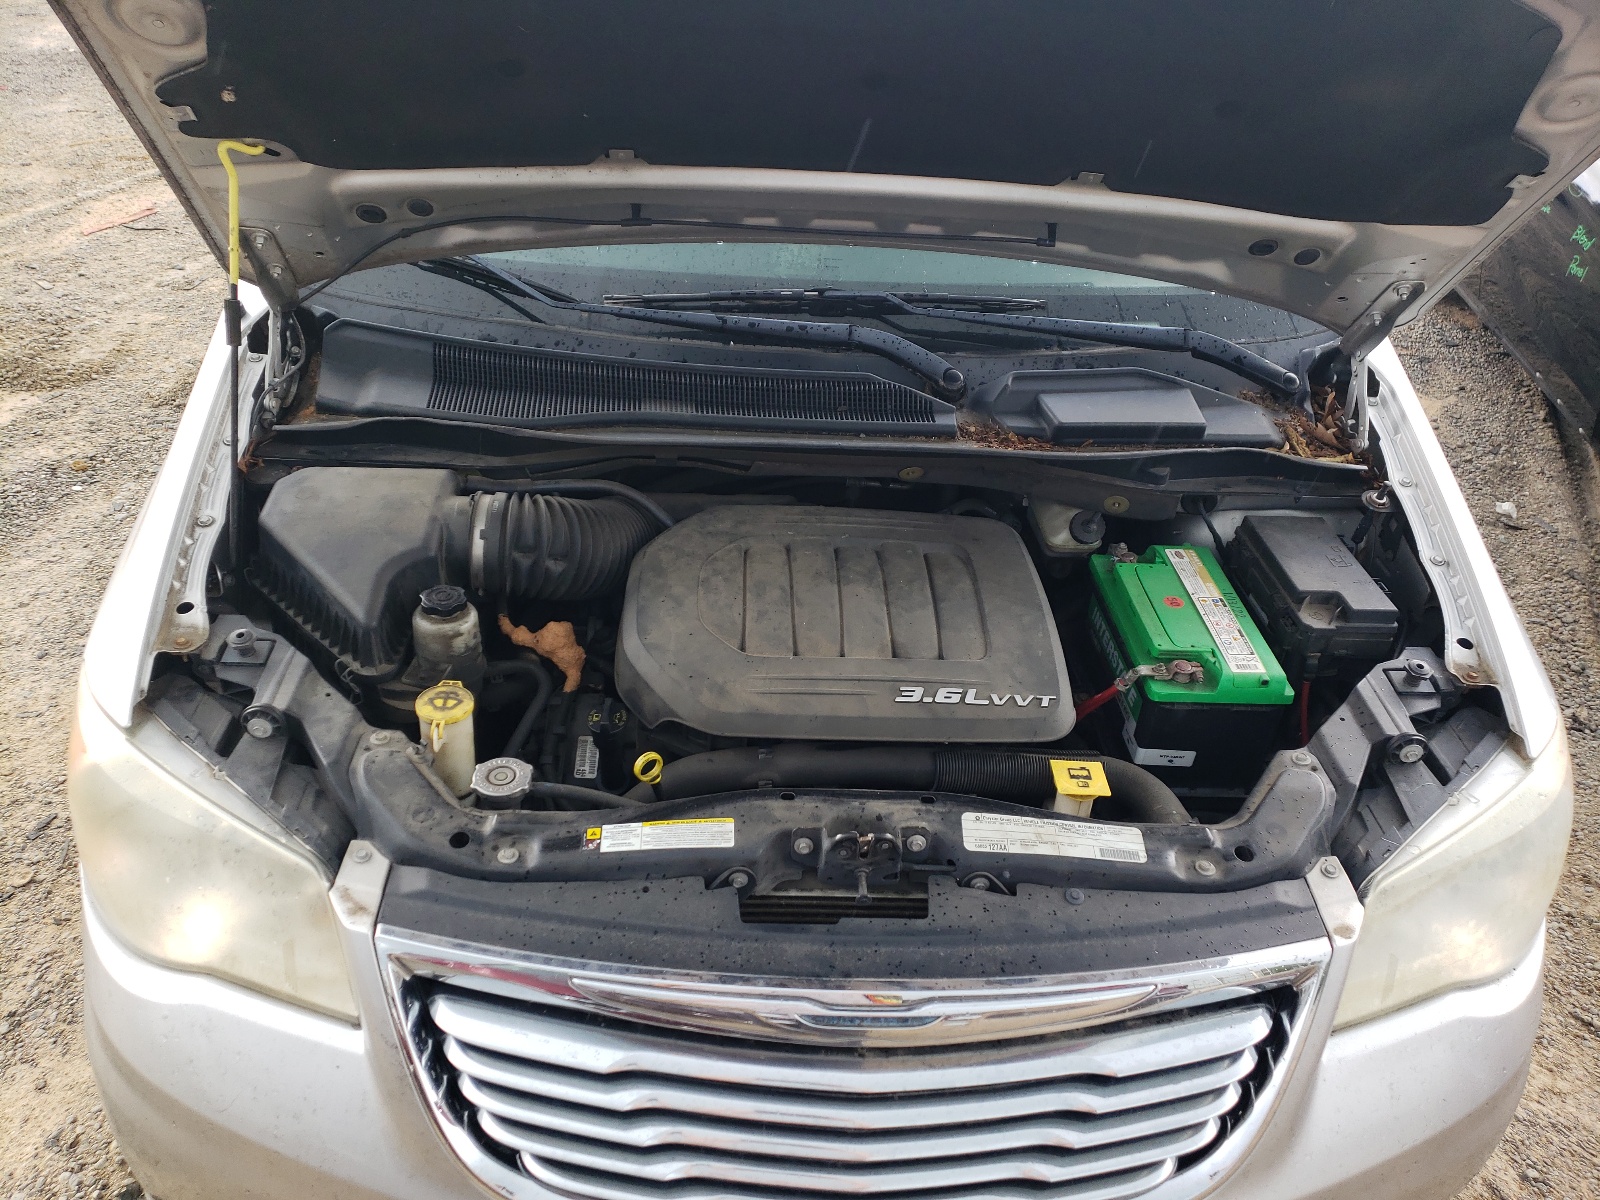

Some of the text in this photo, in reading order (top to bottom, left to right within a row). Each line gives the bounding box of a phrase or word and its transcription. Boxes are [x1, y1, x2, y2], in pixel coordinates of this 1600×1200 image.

[1092, 606, 1137, 707] INTERSTE
[894, 686, 1057, 708] 3.6L VVT
[988, 844, 1008, 852] 127AA
